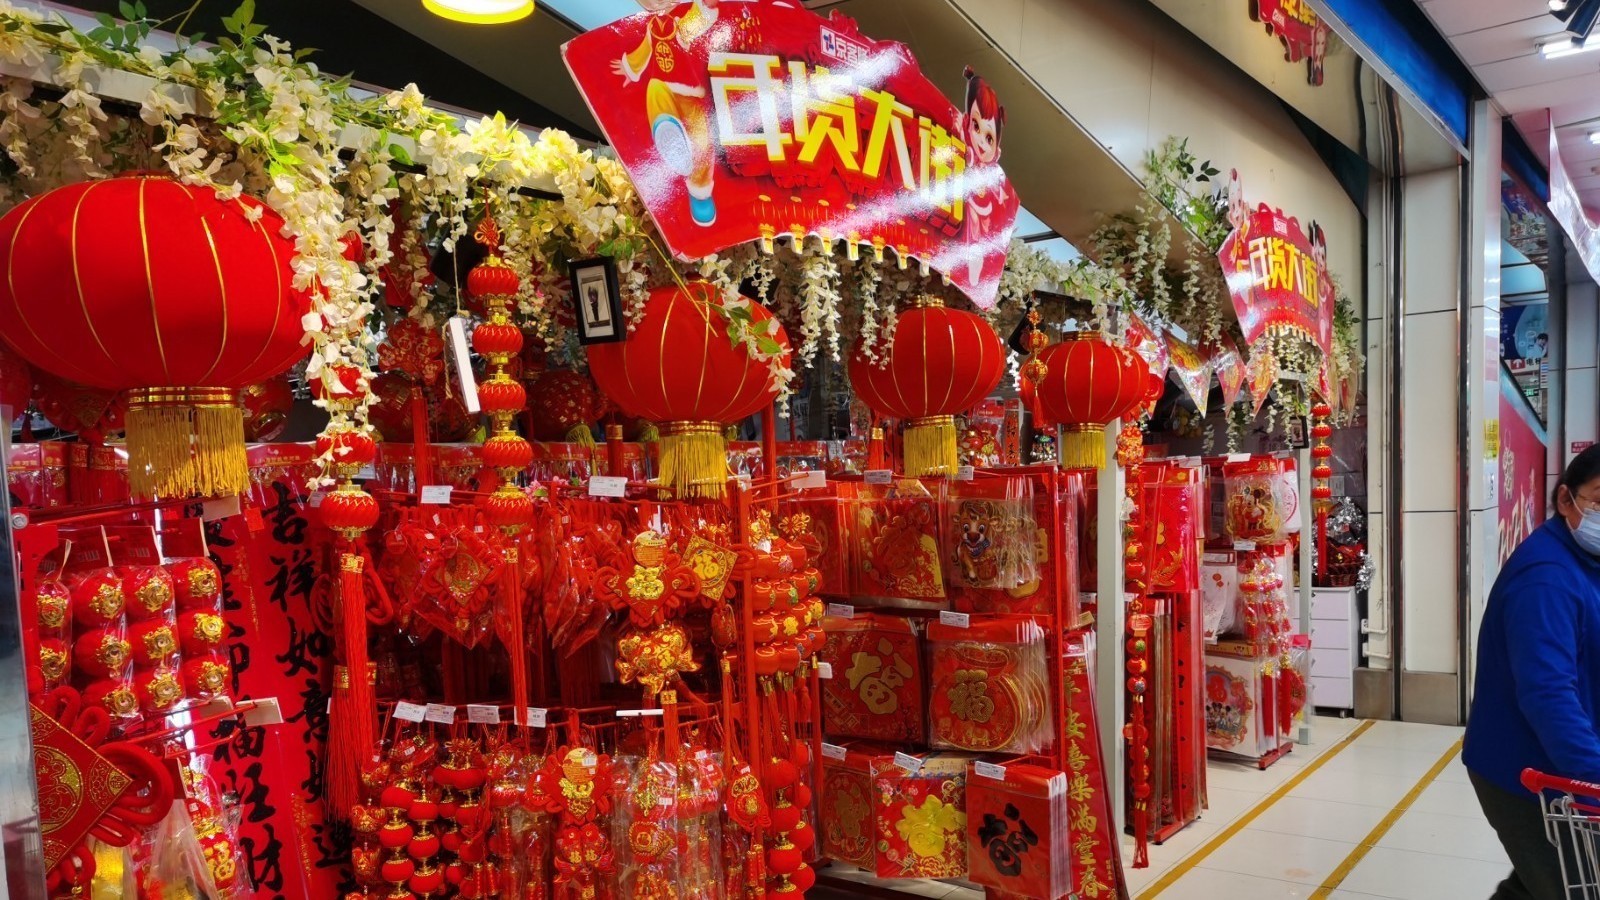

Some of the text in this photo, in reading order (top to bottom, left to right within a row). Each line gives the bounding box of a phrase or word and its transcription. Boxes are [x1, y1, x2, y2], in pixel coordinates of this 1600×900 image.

[708, 51, 967, 223] 年货大街
[1248, 236, 1319, 309] 年货大街
[844, 637, 913, 715] 福
[947, 669, 995, 723] 福
[977, 803, 1038, 877] 福
